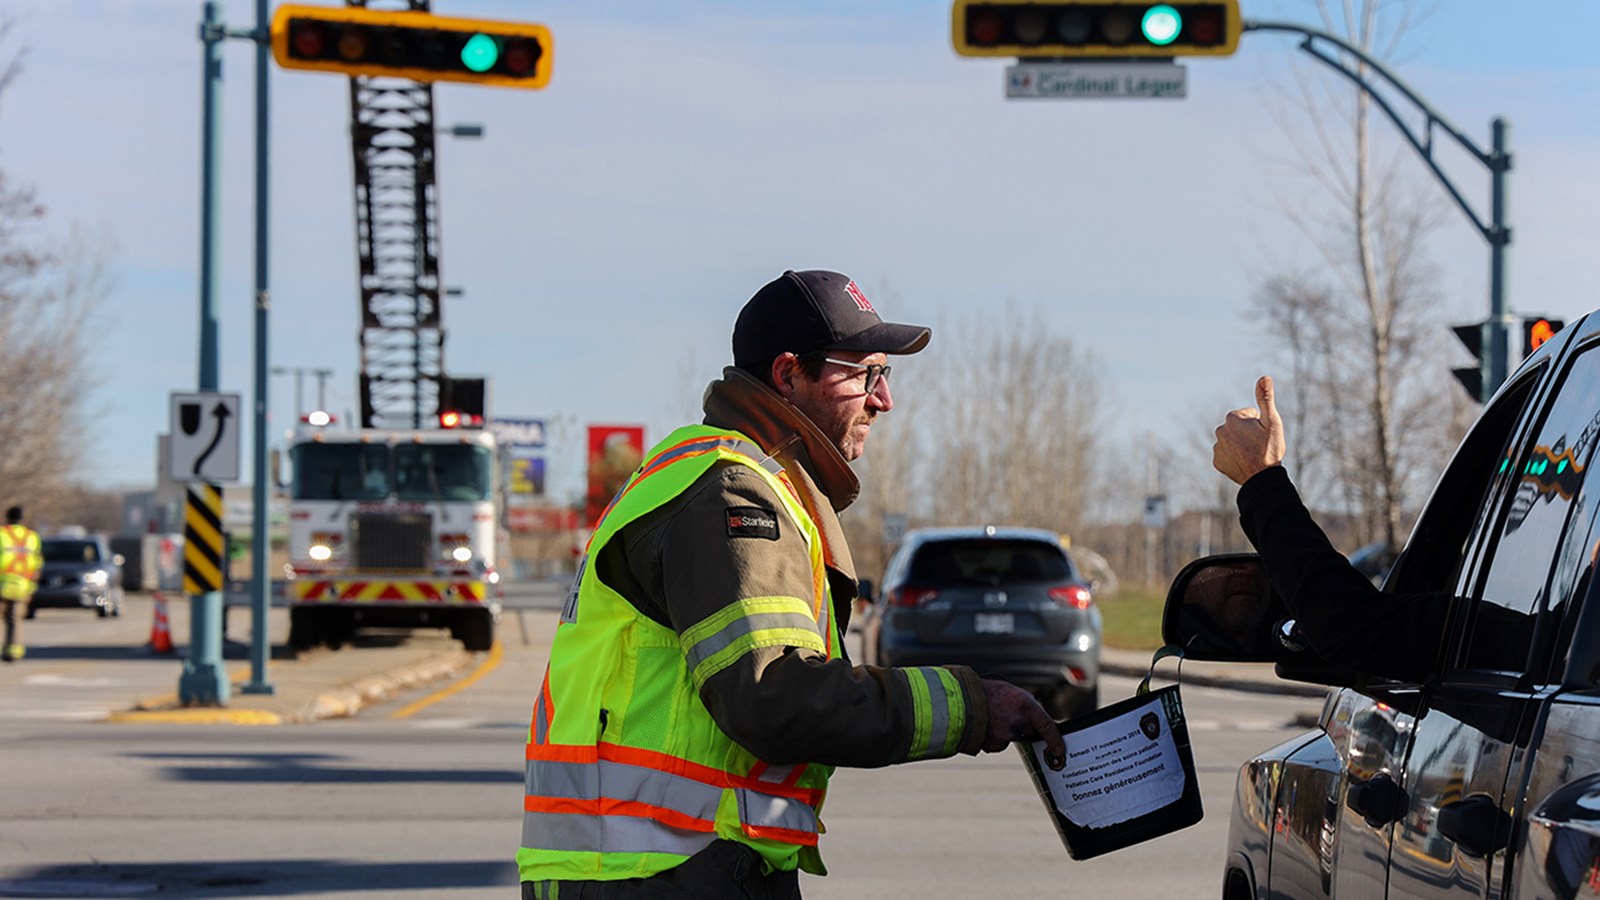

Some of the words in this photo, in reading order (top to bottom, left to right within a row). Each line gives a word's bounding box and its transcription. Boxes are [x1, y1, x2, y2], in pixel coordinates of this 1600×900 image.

[1037, 74, 1119, 94] Cardinal
[1062, 768, 1088, 779] Fondation
[1089, 761, 1110, 772] Maison
[1111, 757, 1121, 766] des
[1123, 751, 1138, 762] soins
[1138, 742, 1159, 755] palliatifs
[1069, 748, 1089, 758] Samedi
[1099, 736, 1127, 749] novembre
[1065, 779, 1089, 789] Palliative
[1090, 775, 1103, 784] Care
[1104, 765, 1133, 777] Residence
[1134, 751, 1163, 766] Foundation
[1072, 787, 1103, 801] Donnez
[1103, 763, 1165, 794] généreusement
